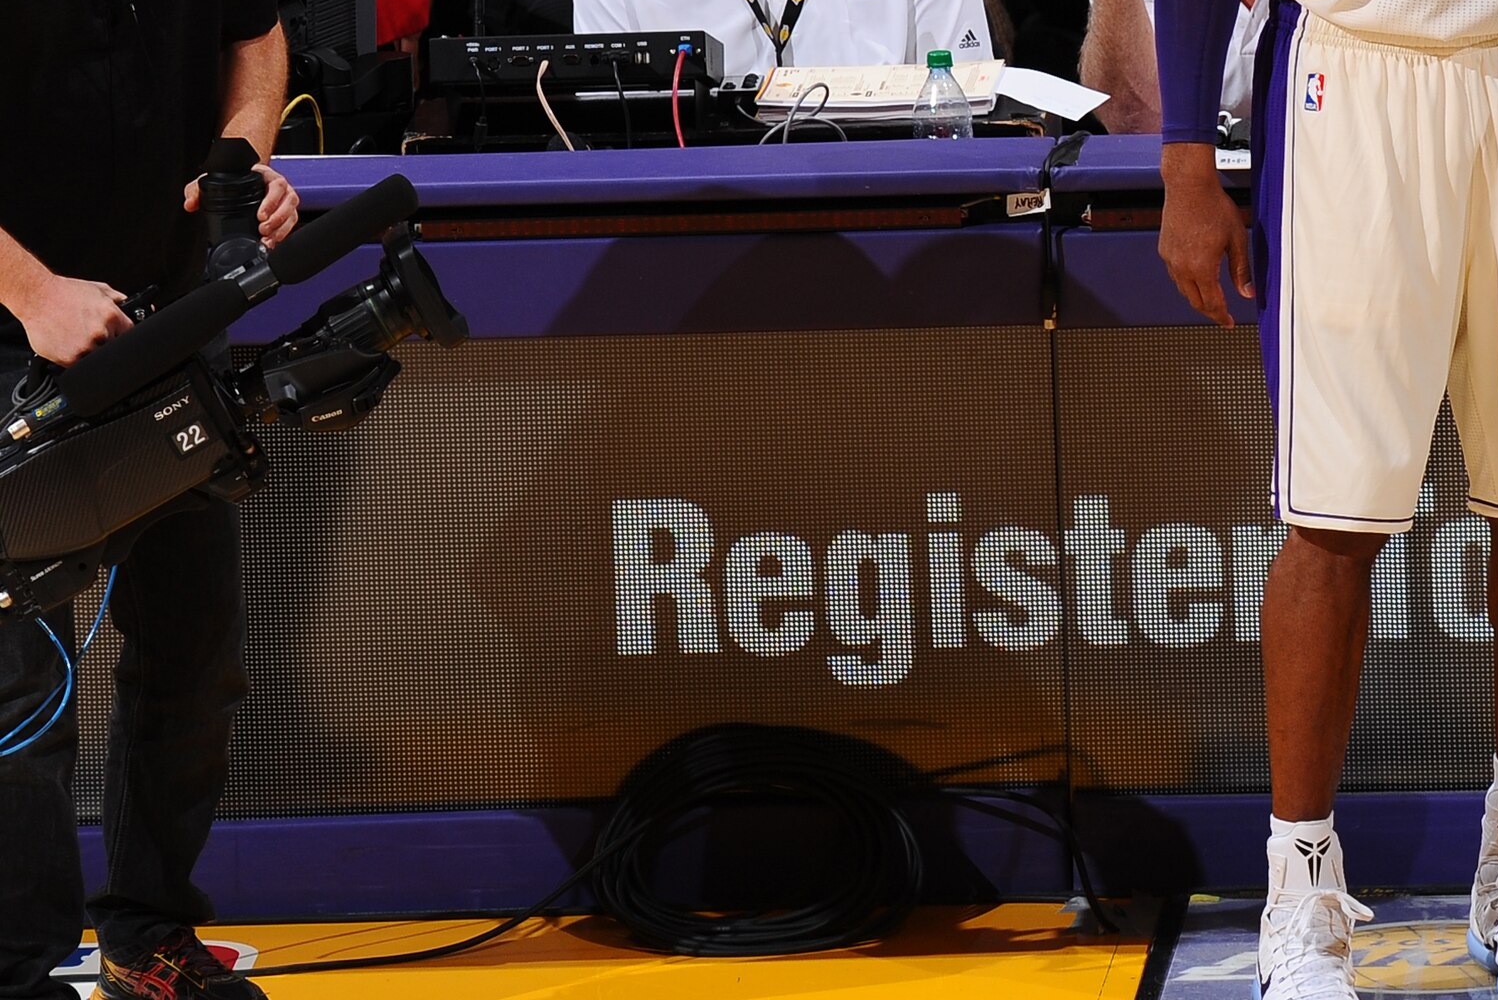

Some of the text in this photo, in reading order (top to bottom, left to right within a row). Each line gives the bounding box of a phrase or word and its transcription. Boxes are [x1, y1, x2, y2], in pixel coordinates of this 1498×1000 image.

[153, 395, 190, 421] SONY
[310, 408, 344, 423] Canon
[175, 424, 206, 452] 22
[611, 490, 1288, 688] Register
